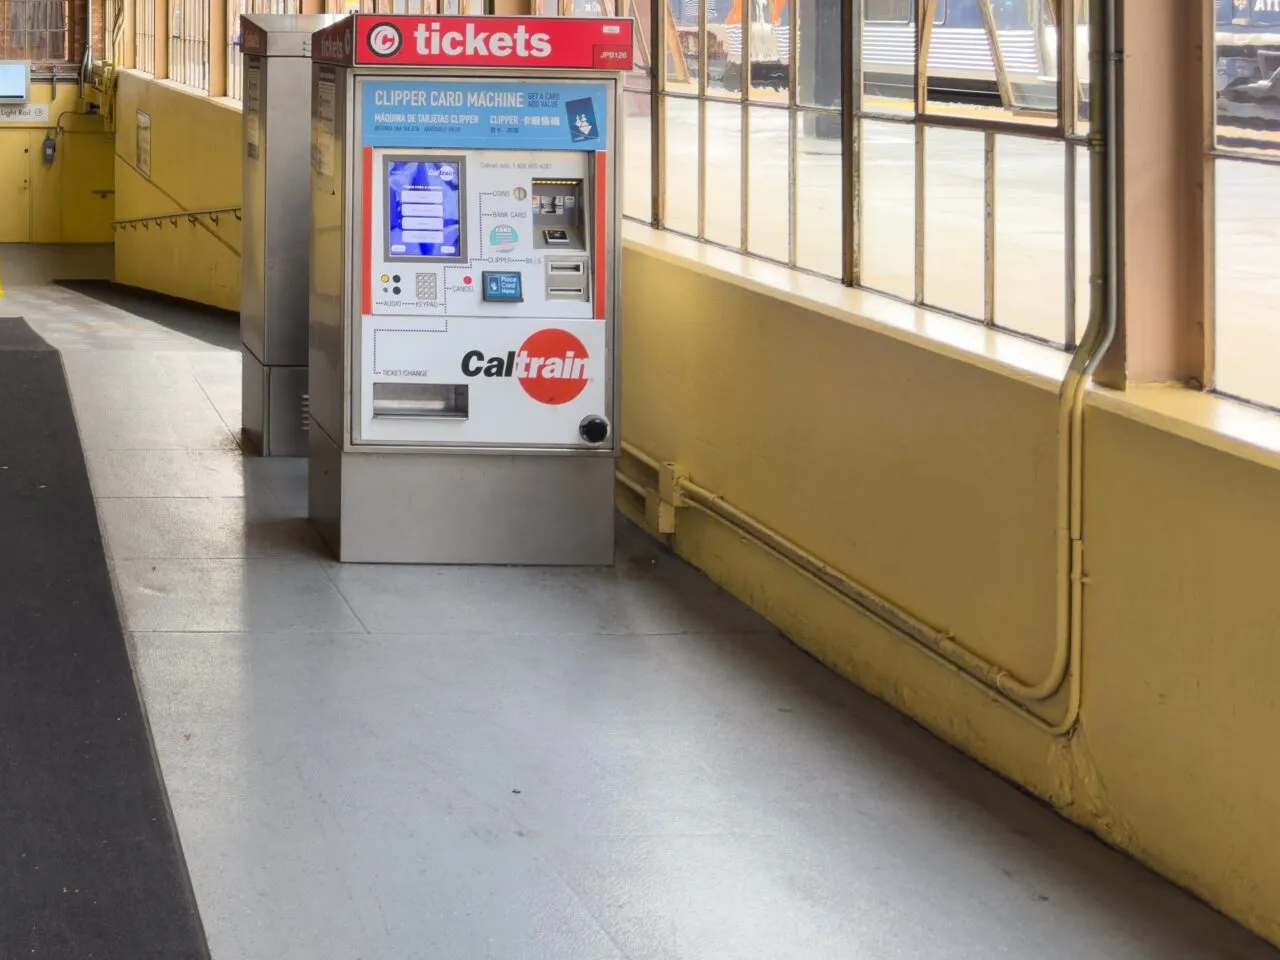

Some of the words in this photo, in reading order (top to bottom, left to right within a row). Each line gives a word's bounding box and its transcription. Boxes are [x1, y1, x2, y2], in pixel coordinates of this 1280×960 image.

[413, 22, 552, 58] tickets
[321, 33, 343, 59] tickets
[599, 51, 628, 60] JPB126
[375, 90, 428, 107] CLIPPER
[430, 91, 463, 107] CARD
[467, 92, 524, 109] MACHINE
[527, 92, 539, 101] GET
[545, 93, 560, 102] CARD
[527, 100, 539, 108] ADD
[540, 100, 558, 109] VALUE
[0, 108, 17, 118] Light
[18, 108, 31, 116] Rail
[407, 114, 417, 123] DE
[418, 114, 449, 124] TARJETAS
[450, 114, 480, 125] CLIPPER
[489, 114, 519, 125] CLIPPER
[525, 257, 542, 265] BILLS
[461, 349, 592, 380] Caltrain
[382, 369, 429, 378] TICKET/CHANGE
